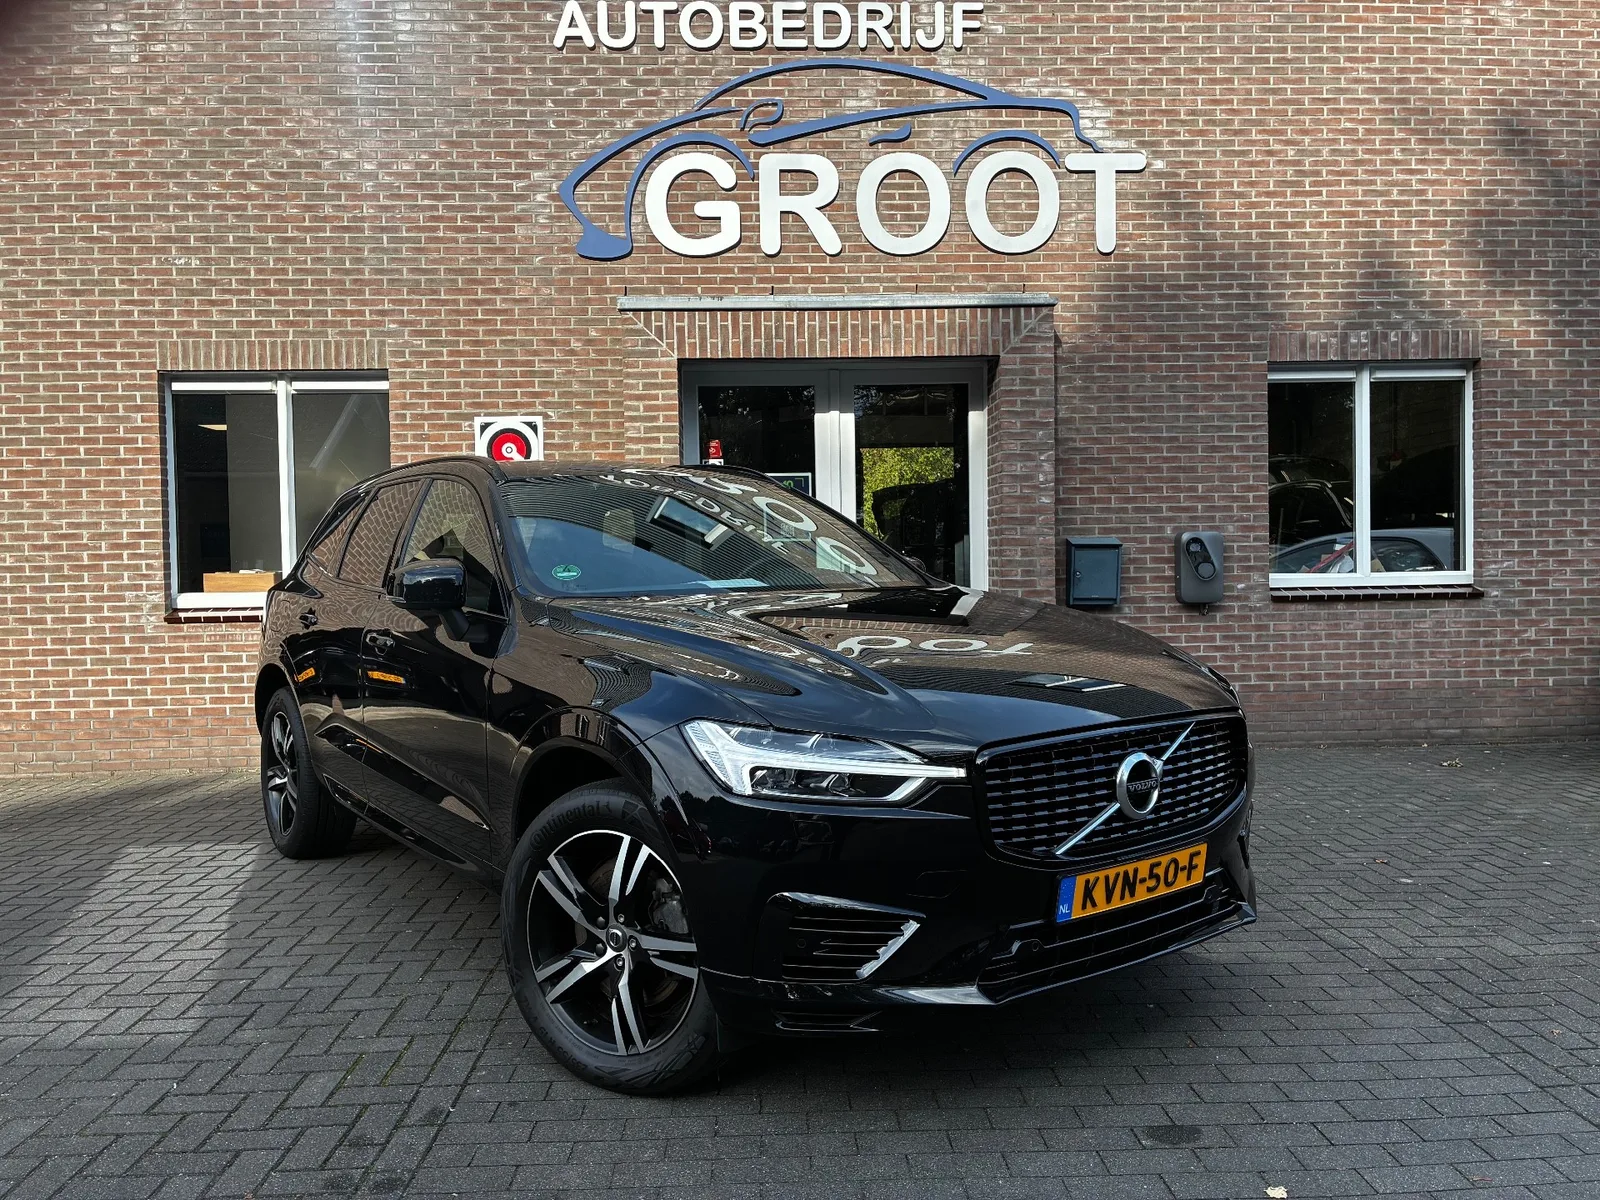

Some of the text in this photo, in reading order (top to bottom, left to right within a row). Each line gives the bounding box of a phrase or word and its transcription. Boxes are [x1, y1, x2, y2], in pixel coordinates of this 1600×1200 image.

[553, 1, 984, 50] AUTOBEDRIJF
[645, 151, 1147, 256] GROOT
[1127, 780, 1158, 792] VOLVO
[529, 800, 601, 851] Continental
[1081, 850, 1202, 911] KVN-50-F
[1058, 903, 1071, 915] NL
